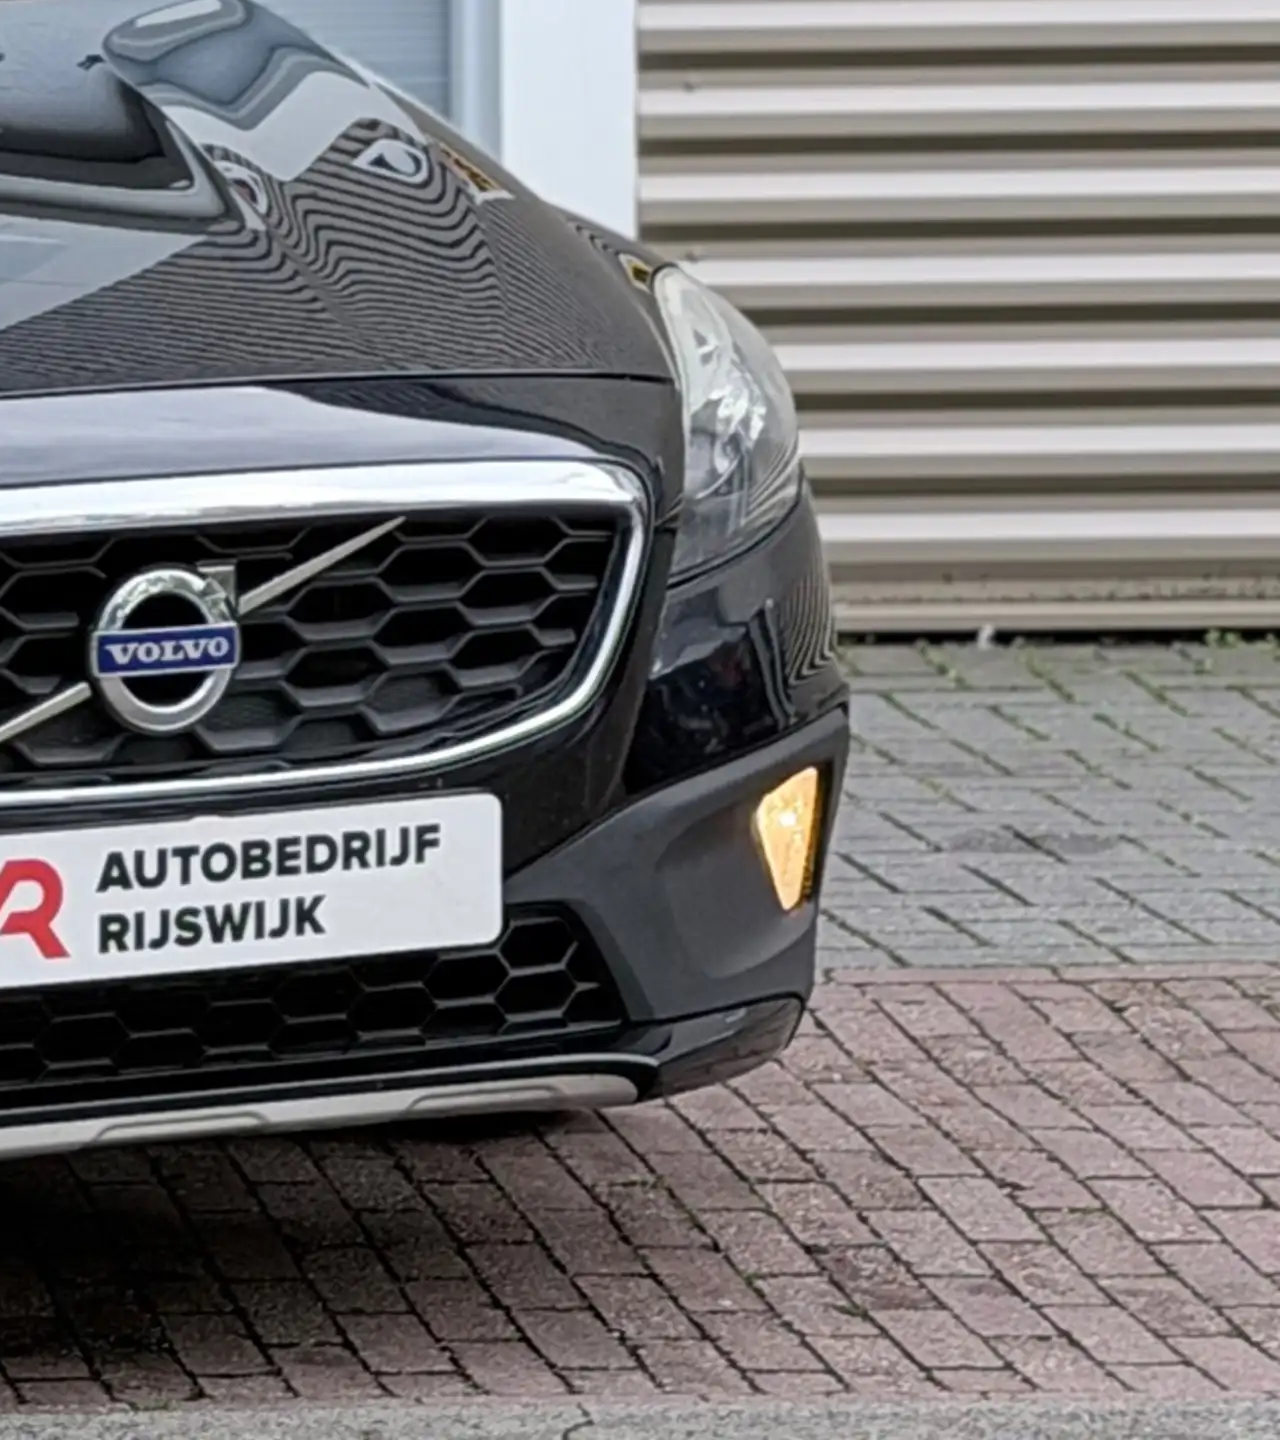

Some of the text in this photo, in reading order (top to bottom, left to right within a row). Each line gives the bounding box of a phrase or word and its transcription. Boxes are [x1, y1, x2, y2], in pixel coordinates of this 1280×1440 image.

[104, 636, 230, 665] VOLVO
[96, 823, 441, 893] AUTOBEDRIJF
[98, 895, 326, 954] RIJSWIJK
